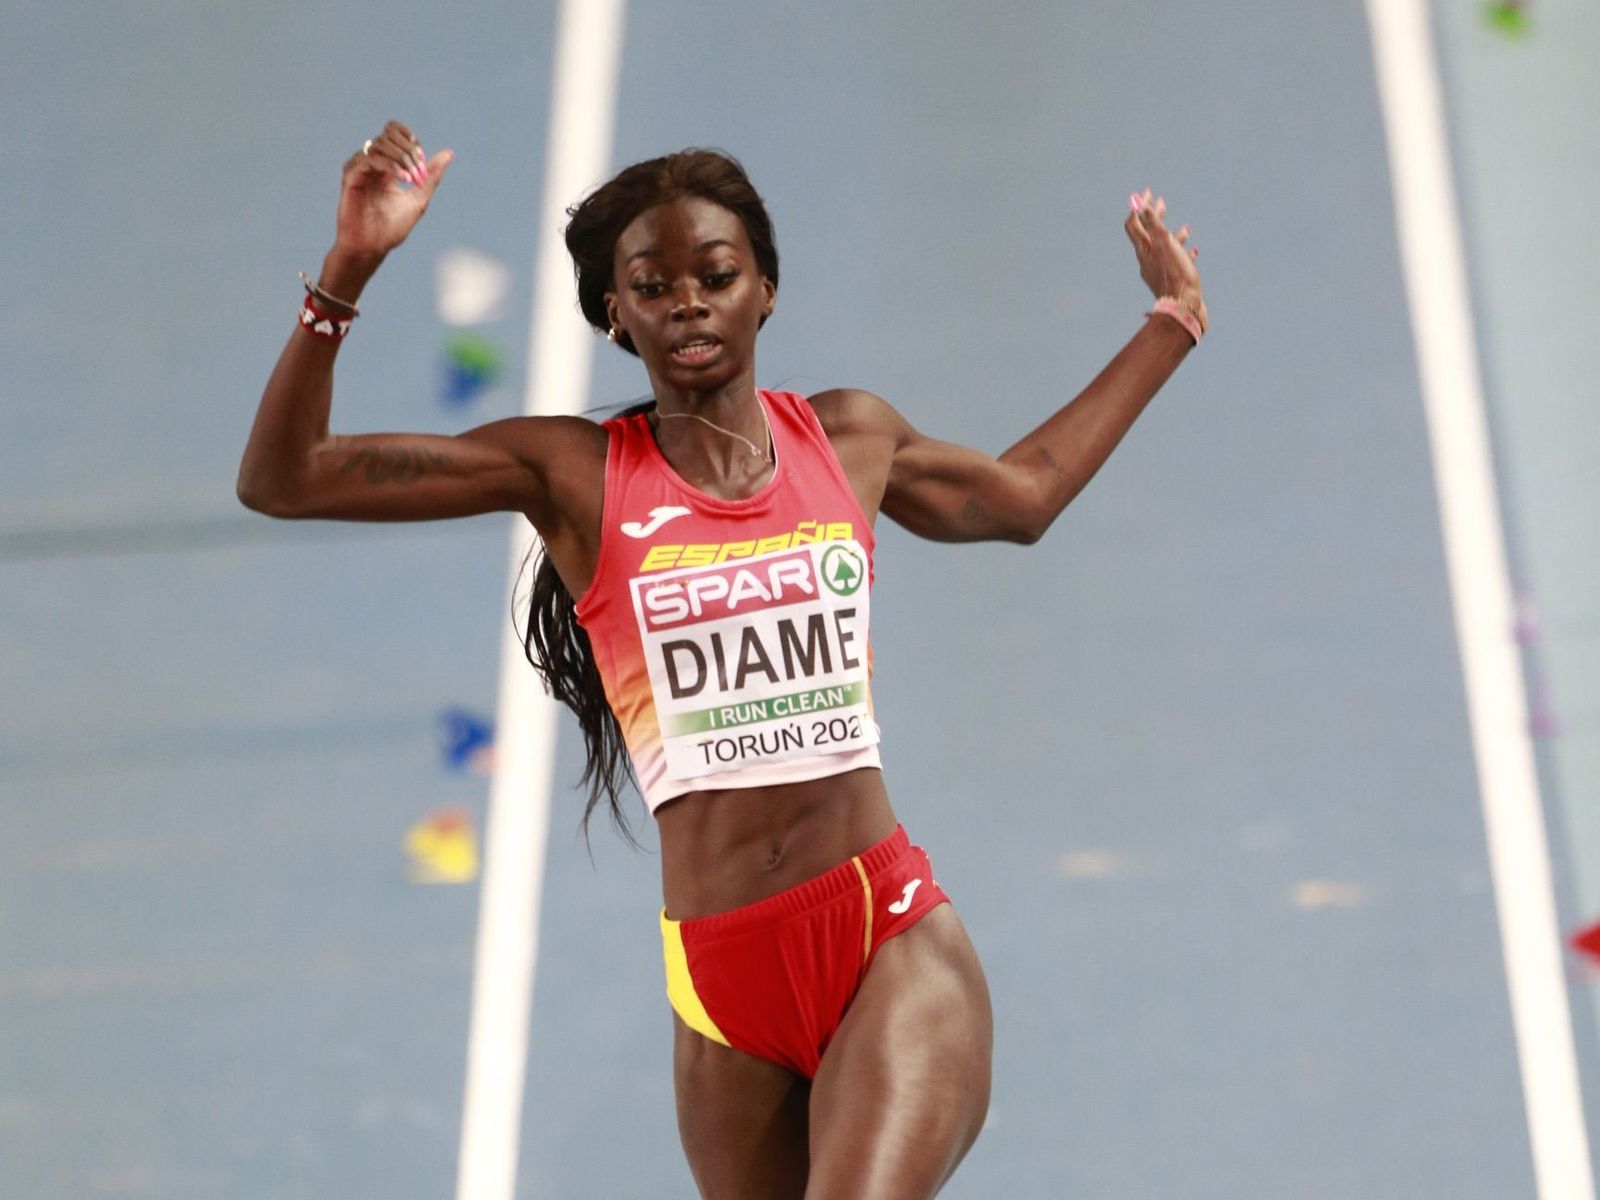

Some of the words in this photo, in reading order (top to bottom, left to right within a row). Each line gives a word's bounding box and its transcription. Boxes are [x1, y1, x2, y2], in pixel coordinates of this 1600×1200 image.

[645, 558, 814, 625] SPAR
[661, 607, 860, 700] DIAME
[709, 710, 716, 728] I
[720, 701, 768, 726] RUN
[697, 722, 804, 765] TORUŃ
